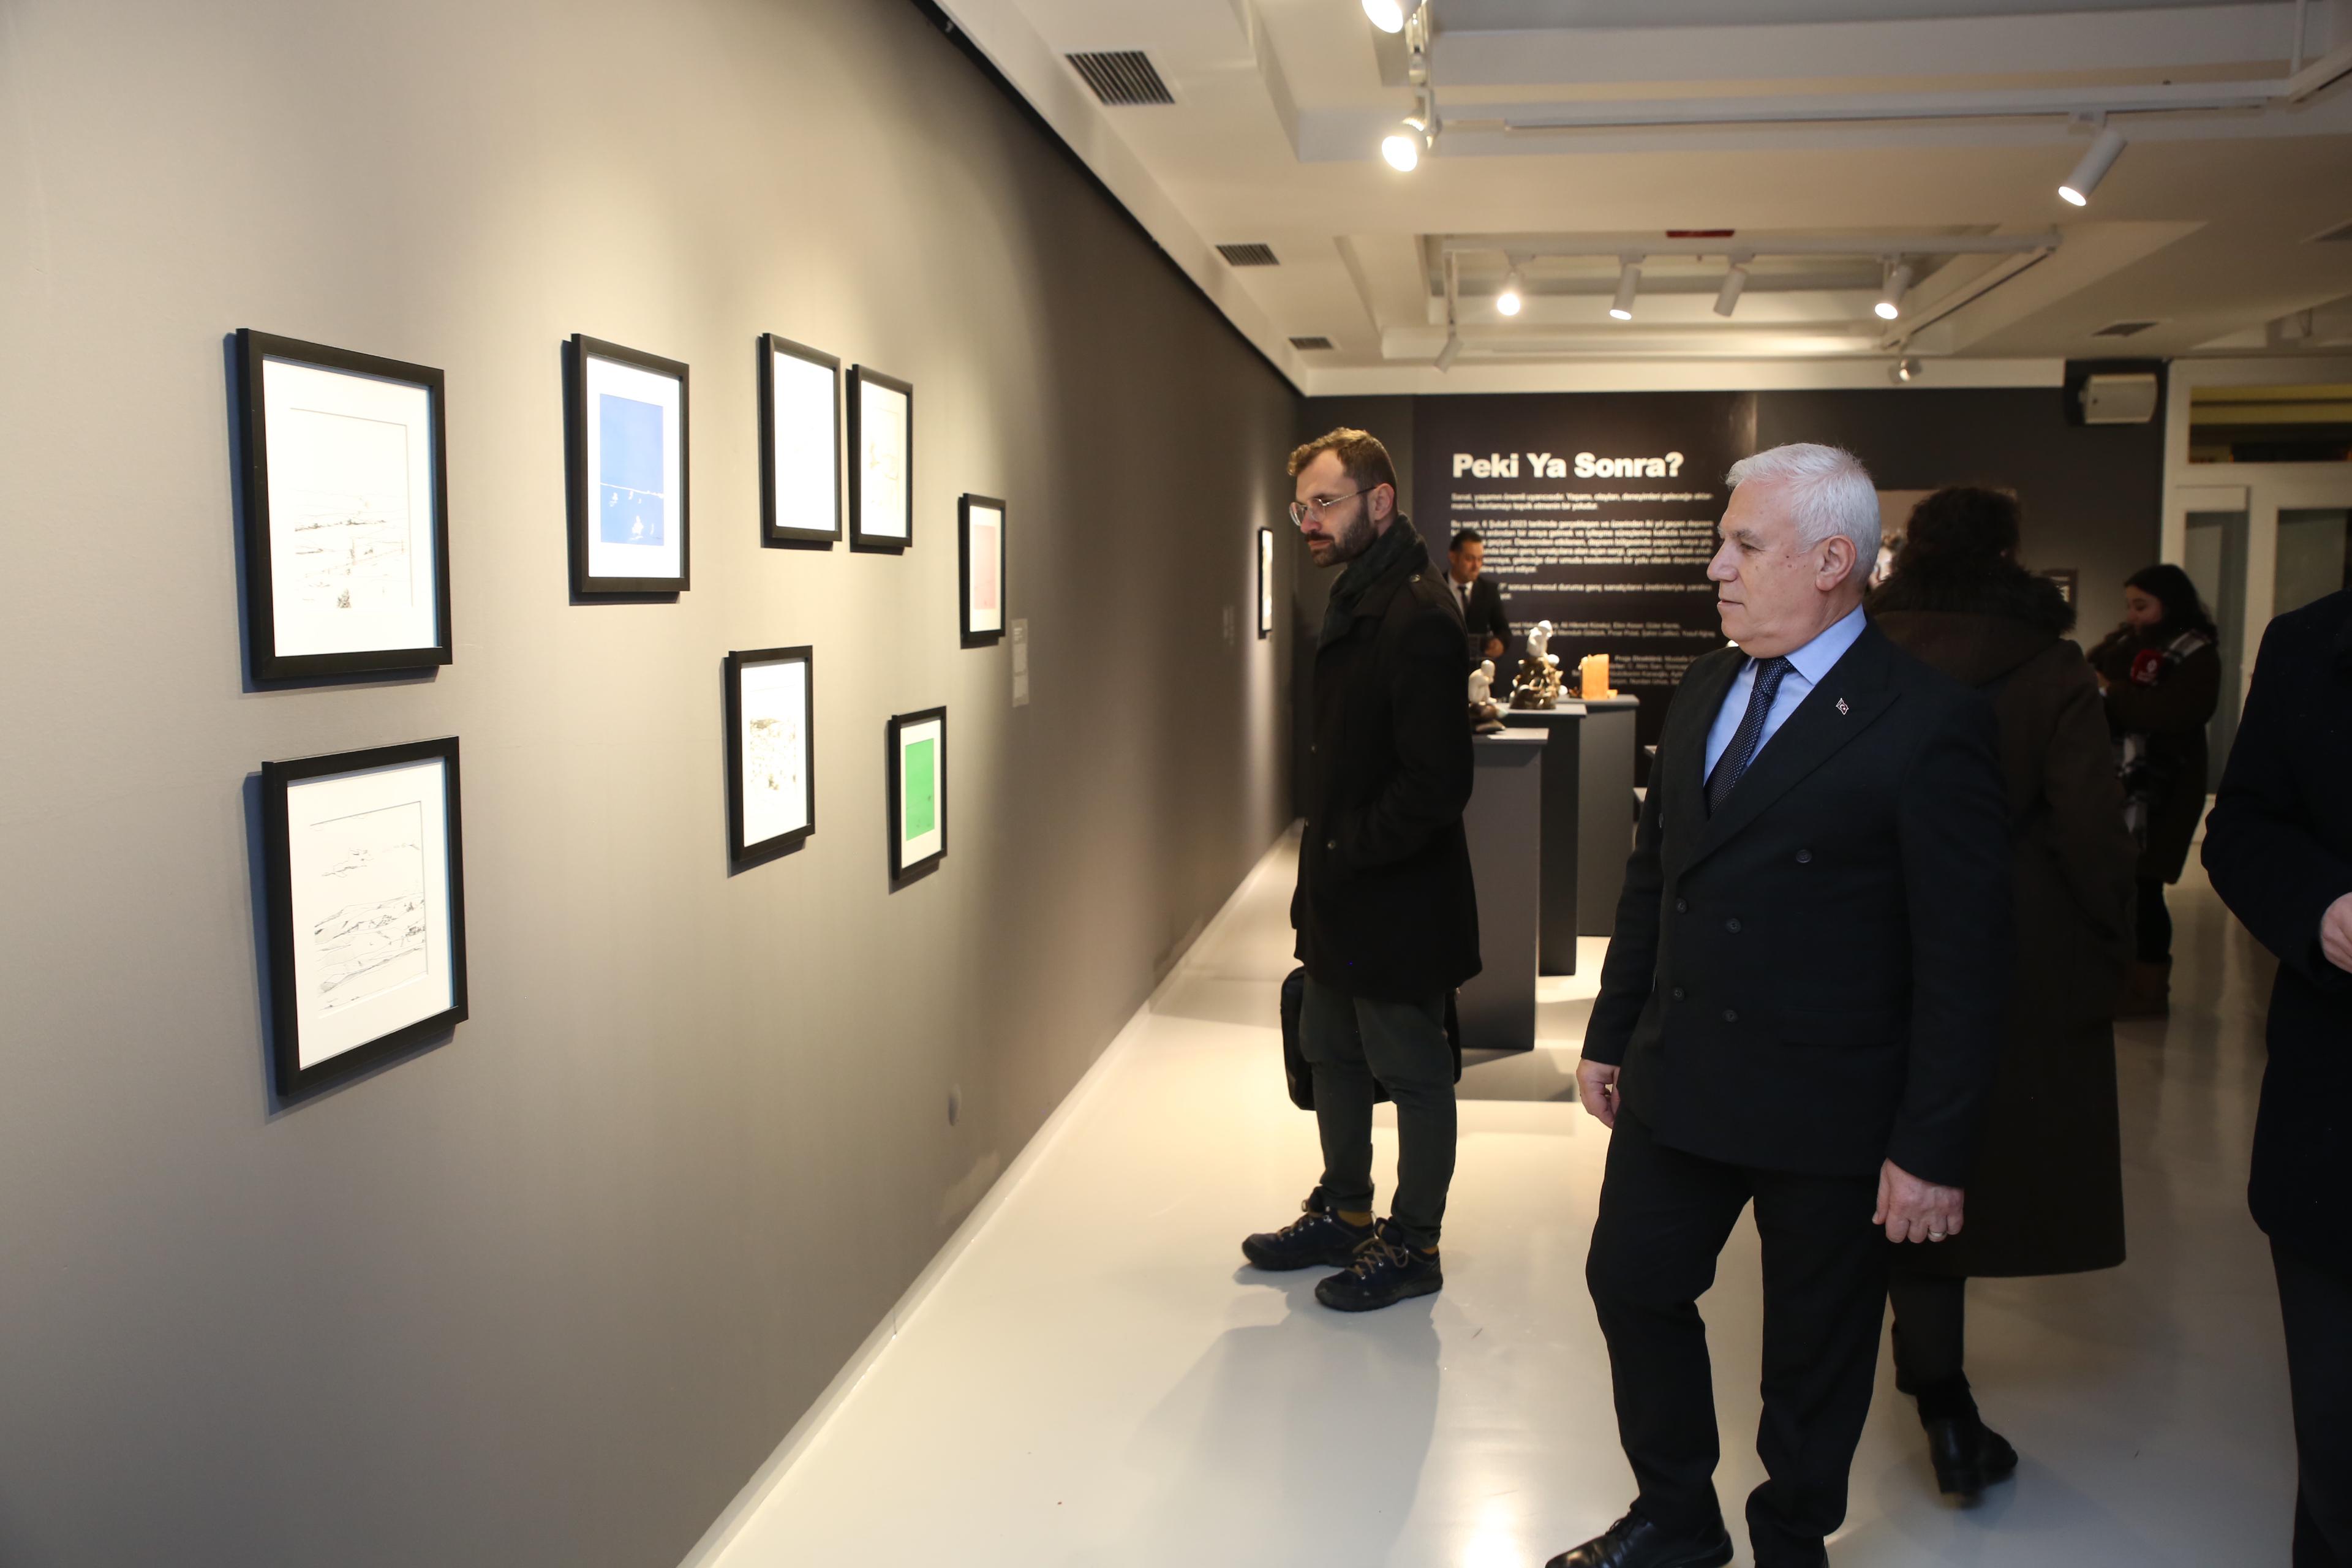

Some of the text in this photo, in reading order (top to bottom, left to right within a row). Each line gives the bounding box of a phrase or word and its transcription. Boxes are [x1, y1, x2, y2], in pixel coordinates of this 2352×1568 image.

[1452, 451, 1684, 478] Peki Ya Sonra?
